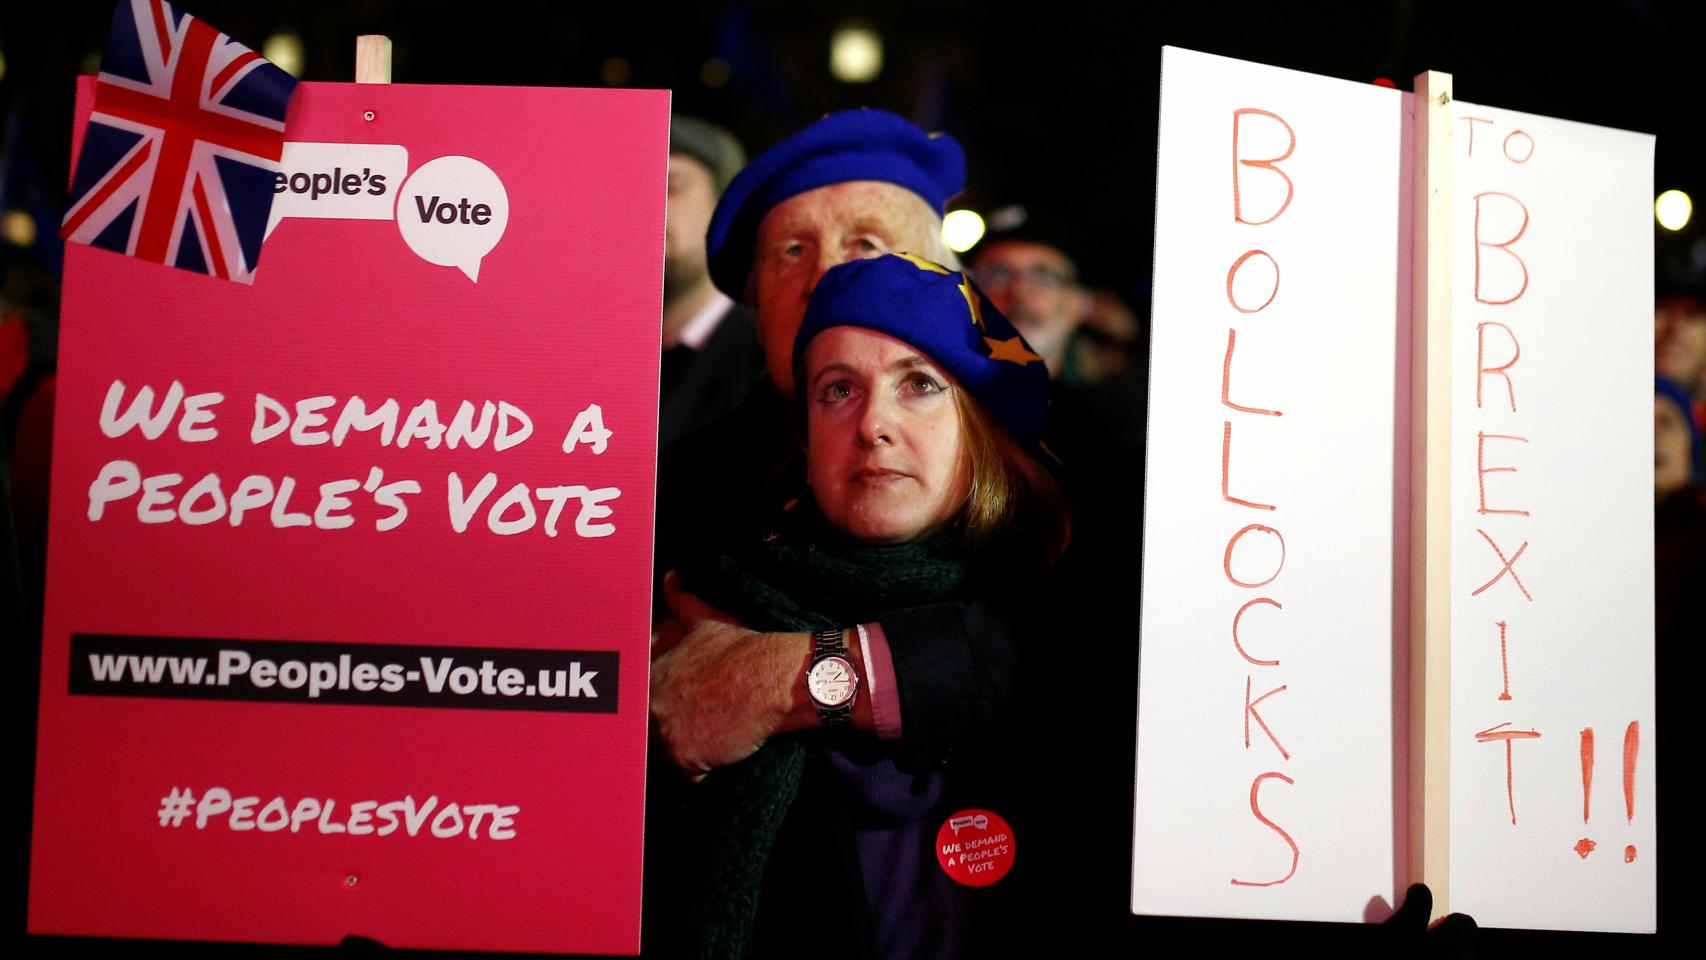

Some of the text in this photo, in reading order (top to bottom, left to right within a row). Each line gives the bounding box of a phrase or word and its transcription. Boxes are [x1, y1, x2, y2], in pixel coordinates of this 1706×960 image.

[1459, 116, 1535, 164] TO
[274, 167, 492, 226] eople's Vote
[99, 379, 614, 455] WE DEMAND A
[87, 460, 622, 538] PEOPLE'S VOTE
[1220, 107, 1300, 888] BOLLOCKS
[89, 650, 599, 698] www.Peoples-Vote.uk
[158, 787, 520, 840] #PEOPLESVOTE
[942, 833, 1007, 855] WE DEMAND
[948, 844, 1009, 867] A PEOPLE'S
[967, 861, 995, 875] VOTE
